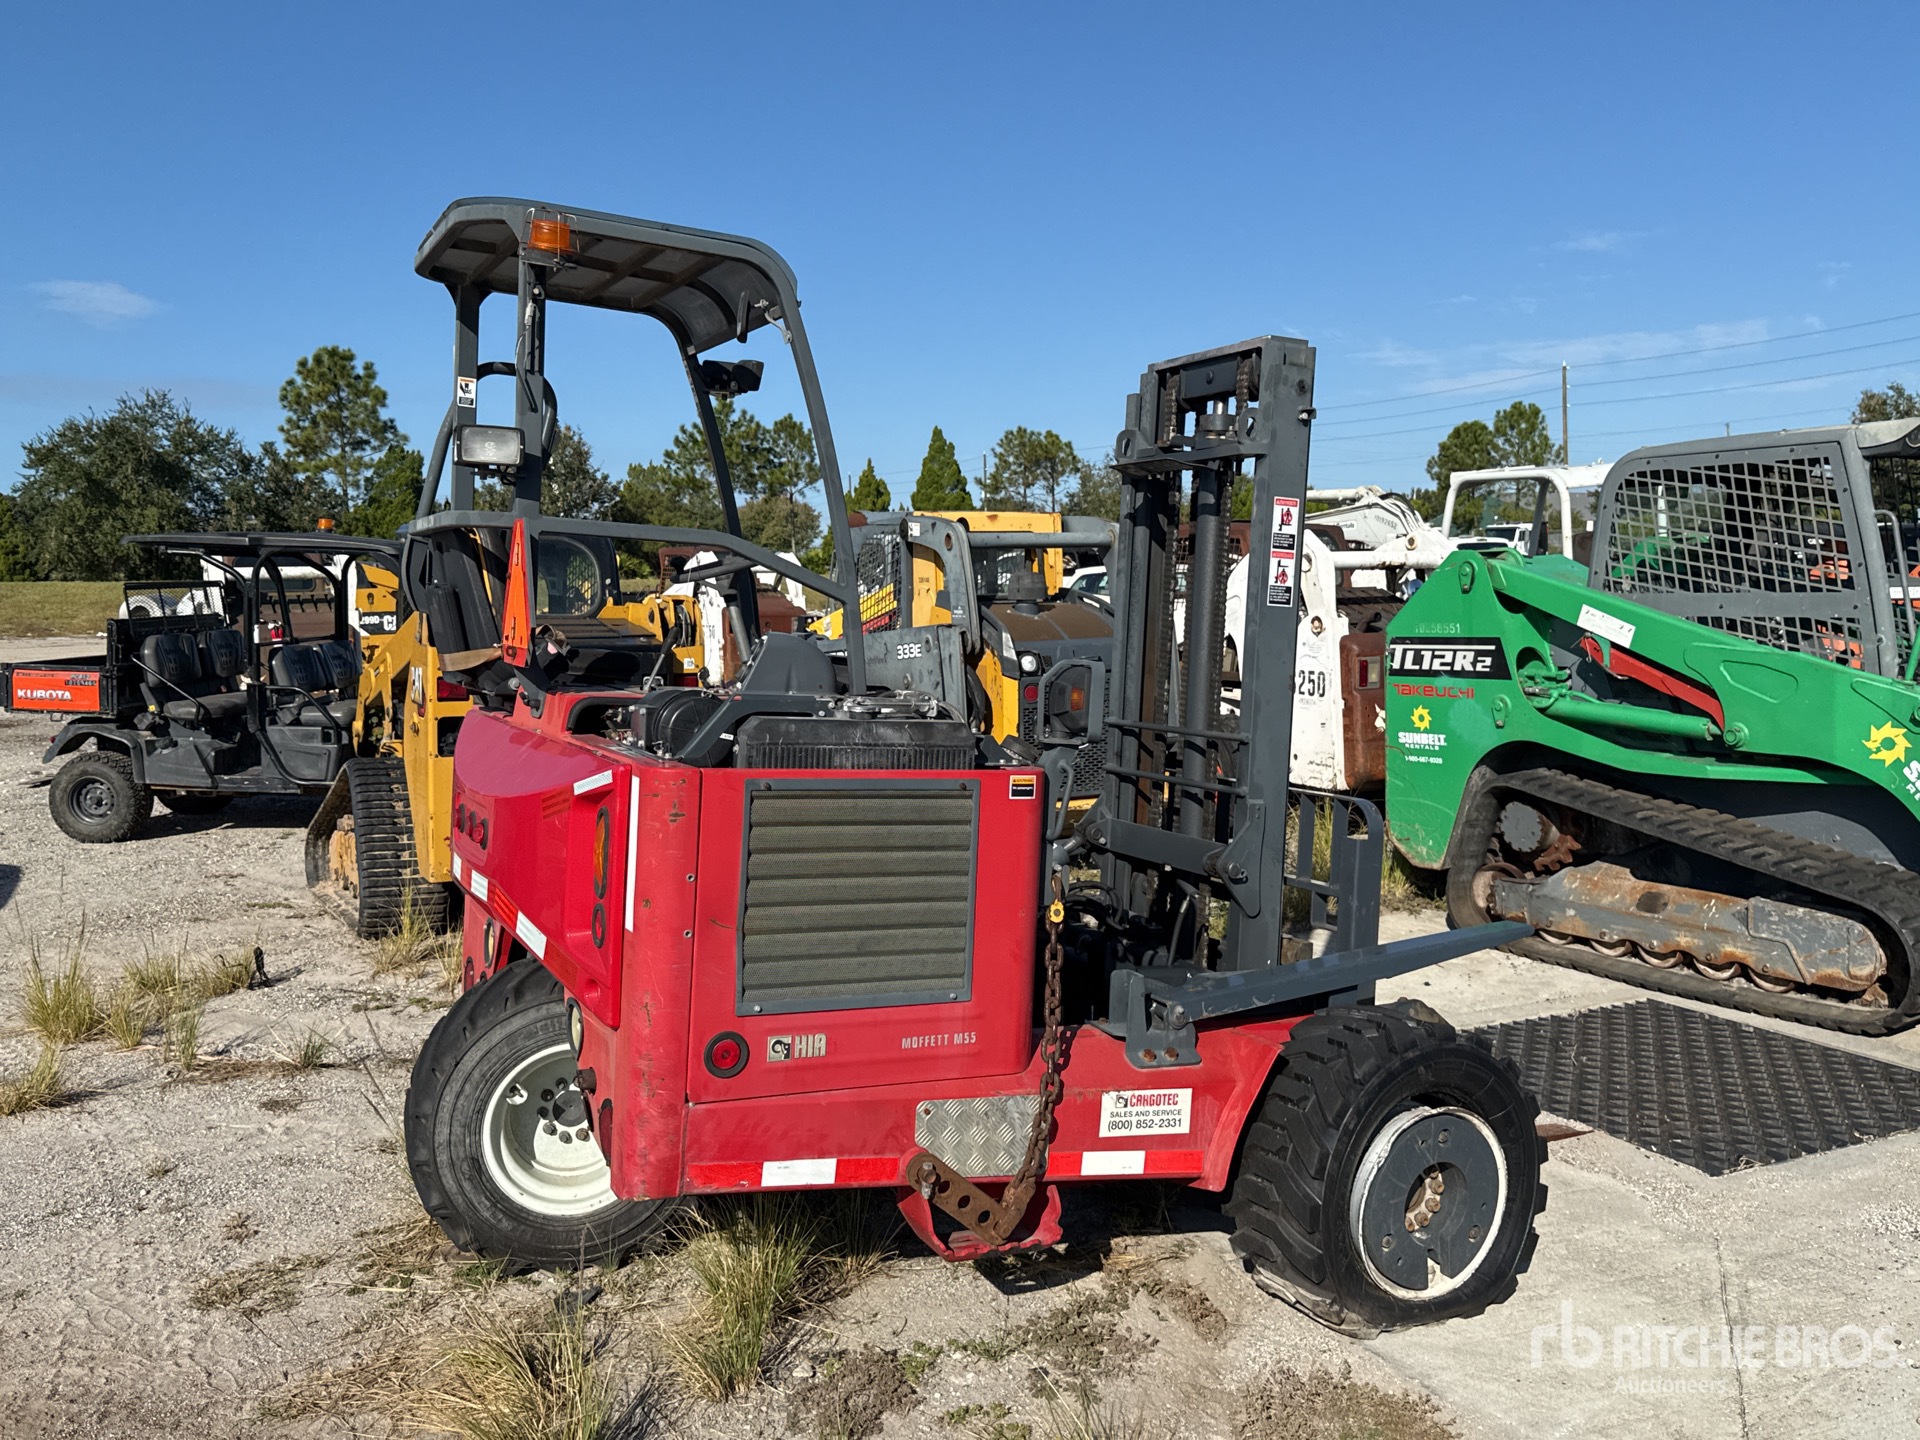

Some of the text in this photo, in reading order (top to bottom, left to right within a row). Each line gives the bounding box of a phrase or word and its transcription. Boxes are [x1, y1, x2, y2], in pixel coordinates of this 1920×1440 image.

[896, 642, 922, 660] 333E
[1389, 644, 1496, 672] TL12R2
[17, 688, 72, 701] KUBOTA
[1398, 732, 1447, 746] SUNBELT
[794, 1033, 827, 1059] HIA
[901, 1032, 977, 1050] MOFFETT M55
[1129, 1093, 1179, 1108] CARGOTEC
[1110, 1110, 1133, 1118] SALES
[1152, 1108, 1182, 1117] SERVICE
[1107, 1118, 1182, 1132] (800) 852-2331
